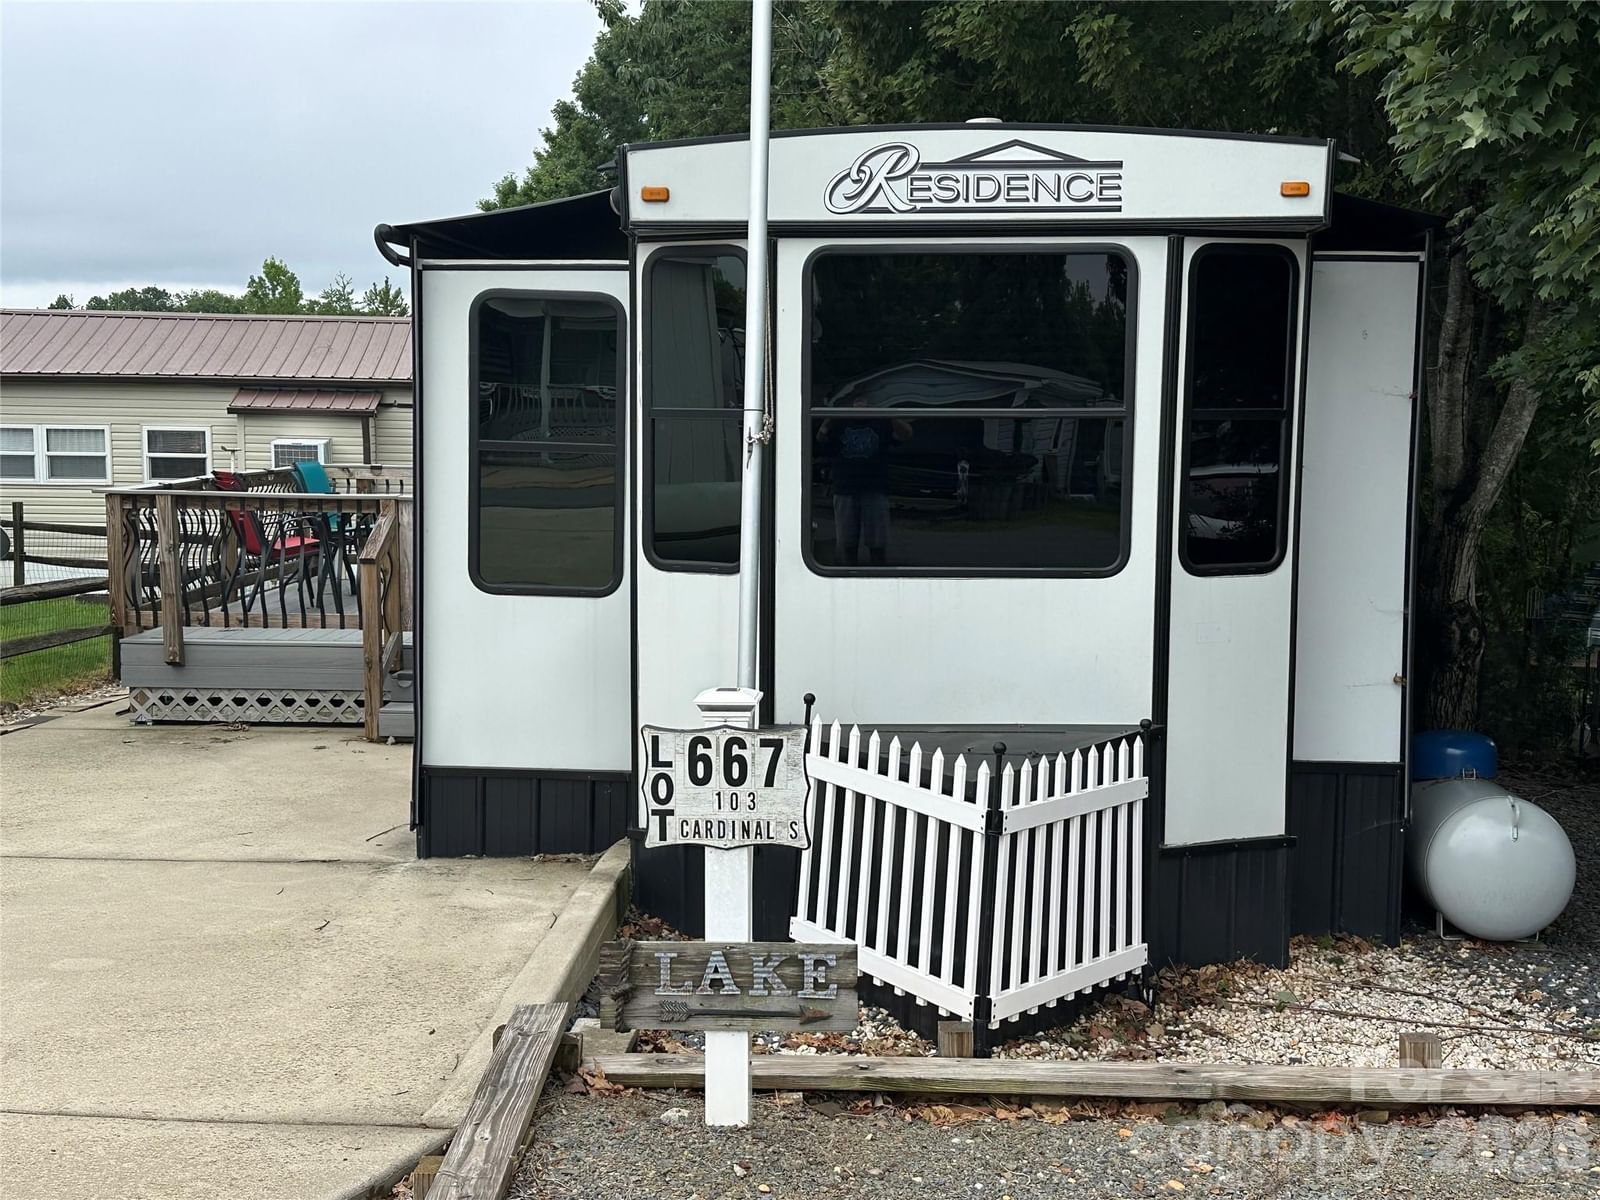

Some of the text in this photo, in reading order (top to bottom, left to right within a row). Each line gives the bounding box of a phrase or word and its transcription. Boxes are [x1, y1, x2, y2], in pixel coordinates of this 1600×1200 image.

[687, 735, 785, 788] 667
[650, 733, 675, 842] LOT
[714, 790, 757, 811] 103
[680, 820, 799, 840] CARDINAL S
[654, 950, 838, 1000] LAKE
